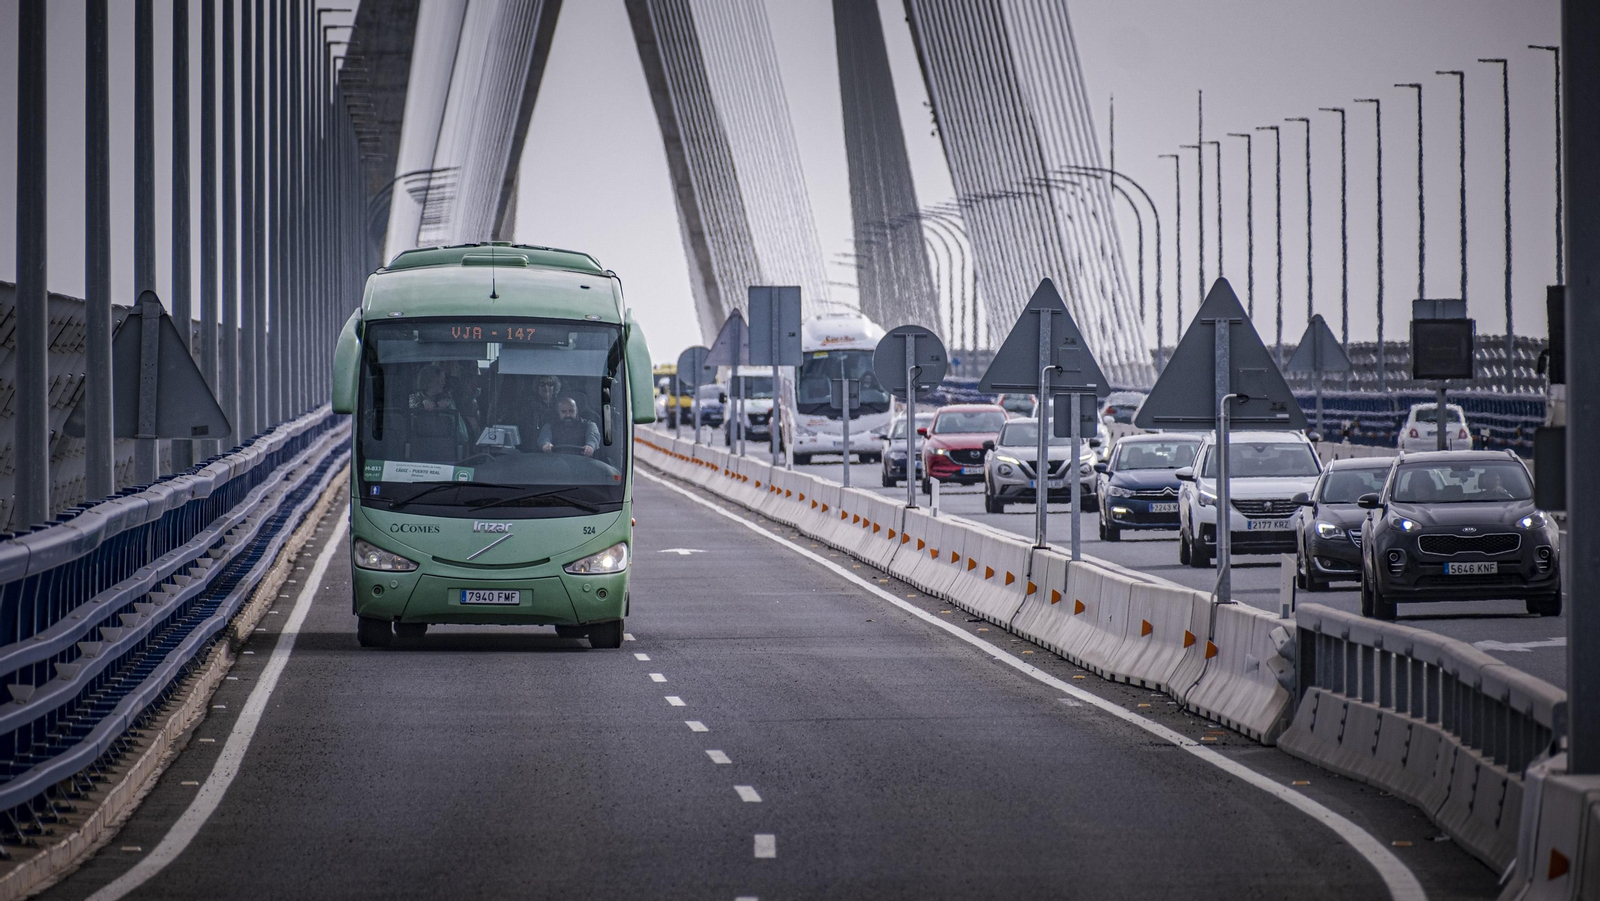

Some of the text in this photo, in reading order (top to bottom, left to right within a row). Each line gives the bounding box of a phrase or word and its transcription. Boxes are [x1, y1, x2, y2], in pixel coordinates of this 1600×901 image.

[451, 327, 482, 339] VJA
[507, 327, 536, 340] 147
[1154, 504, 1172, 512] 2243
[582, 526, 596, 535] 524
[1252, 521, 1290, 530] 2177 KRZ
[1450, 563, 1495, 574] 5646 KNF
[468, 591, 516, 602] 7940 FMF
